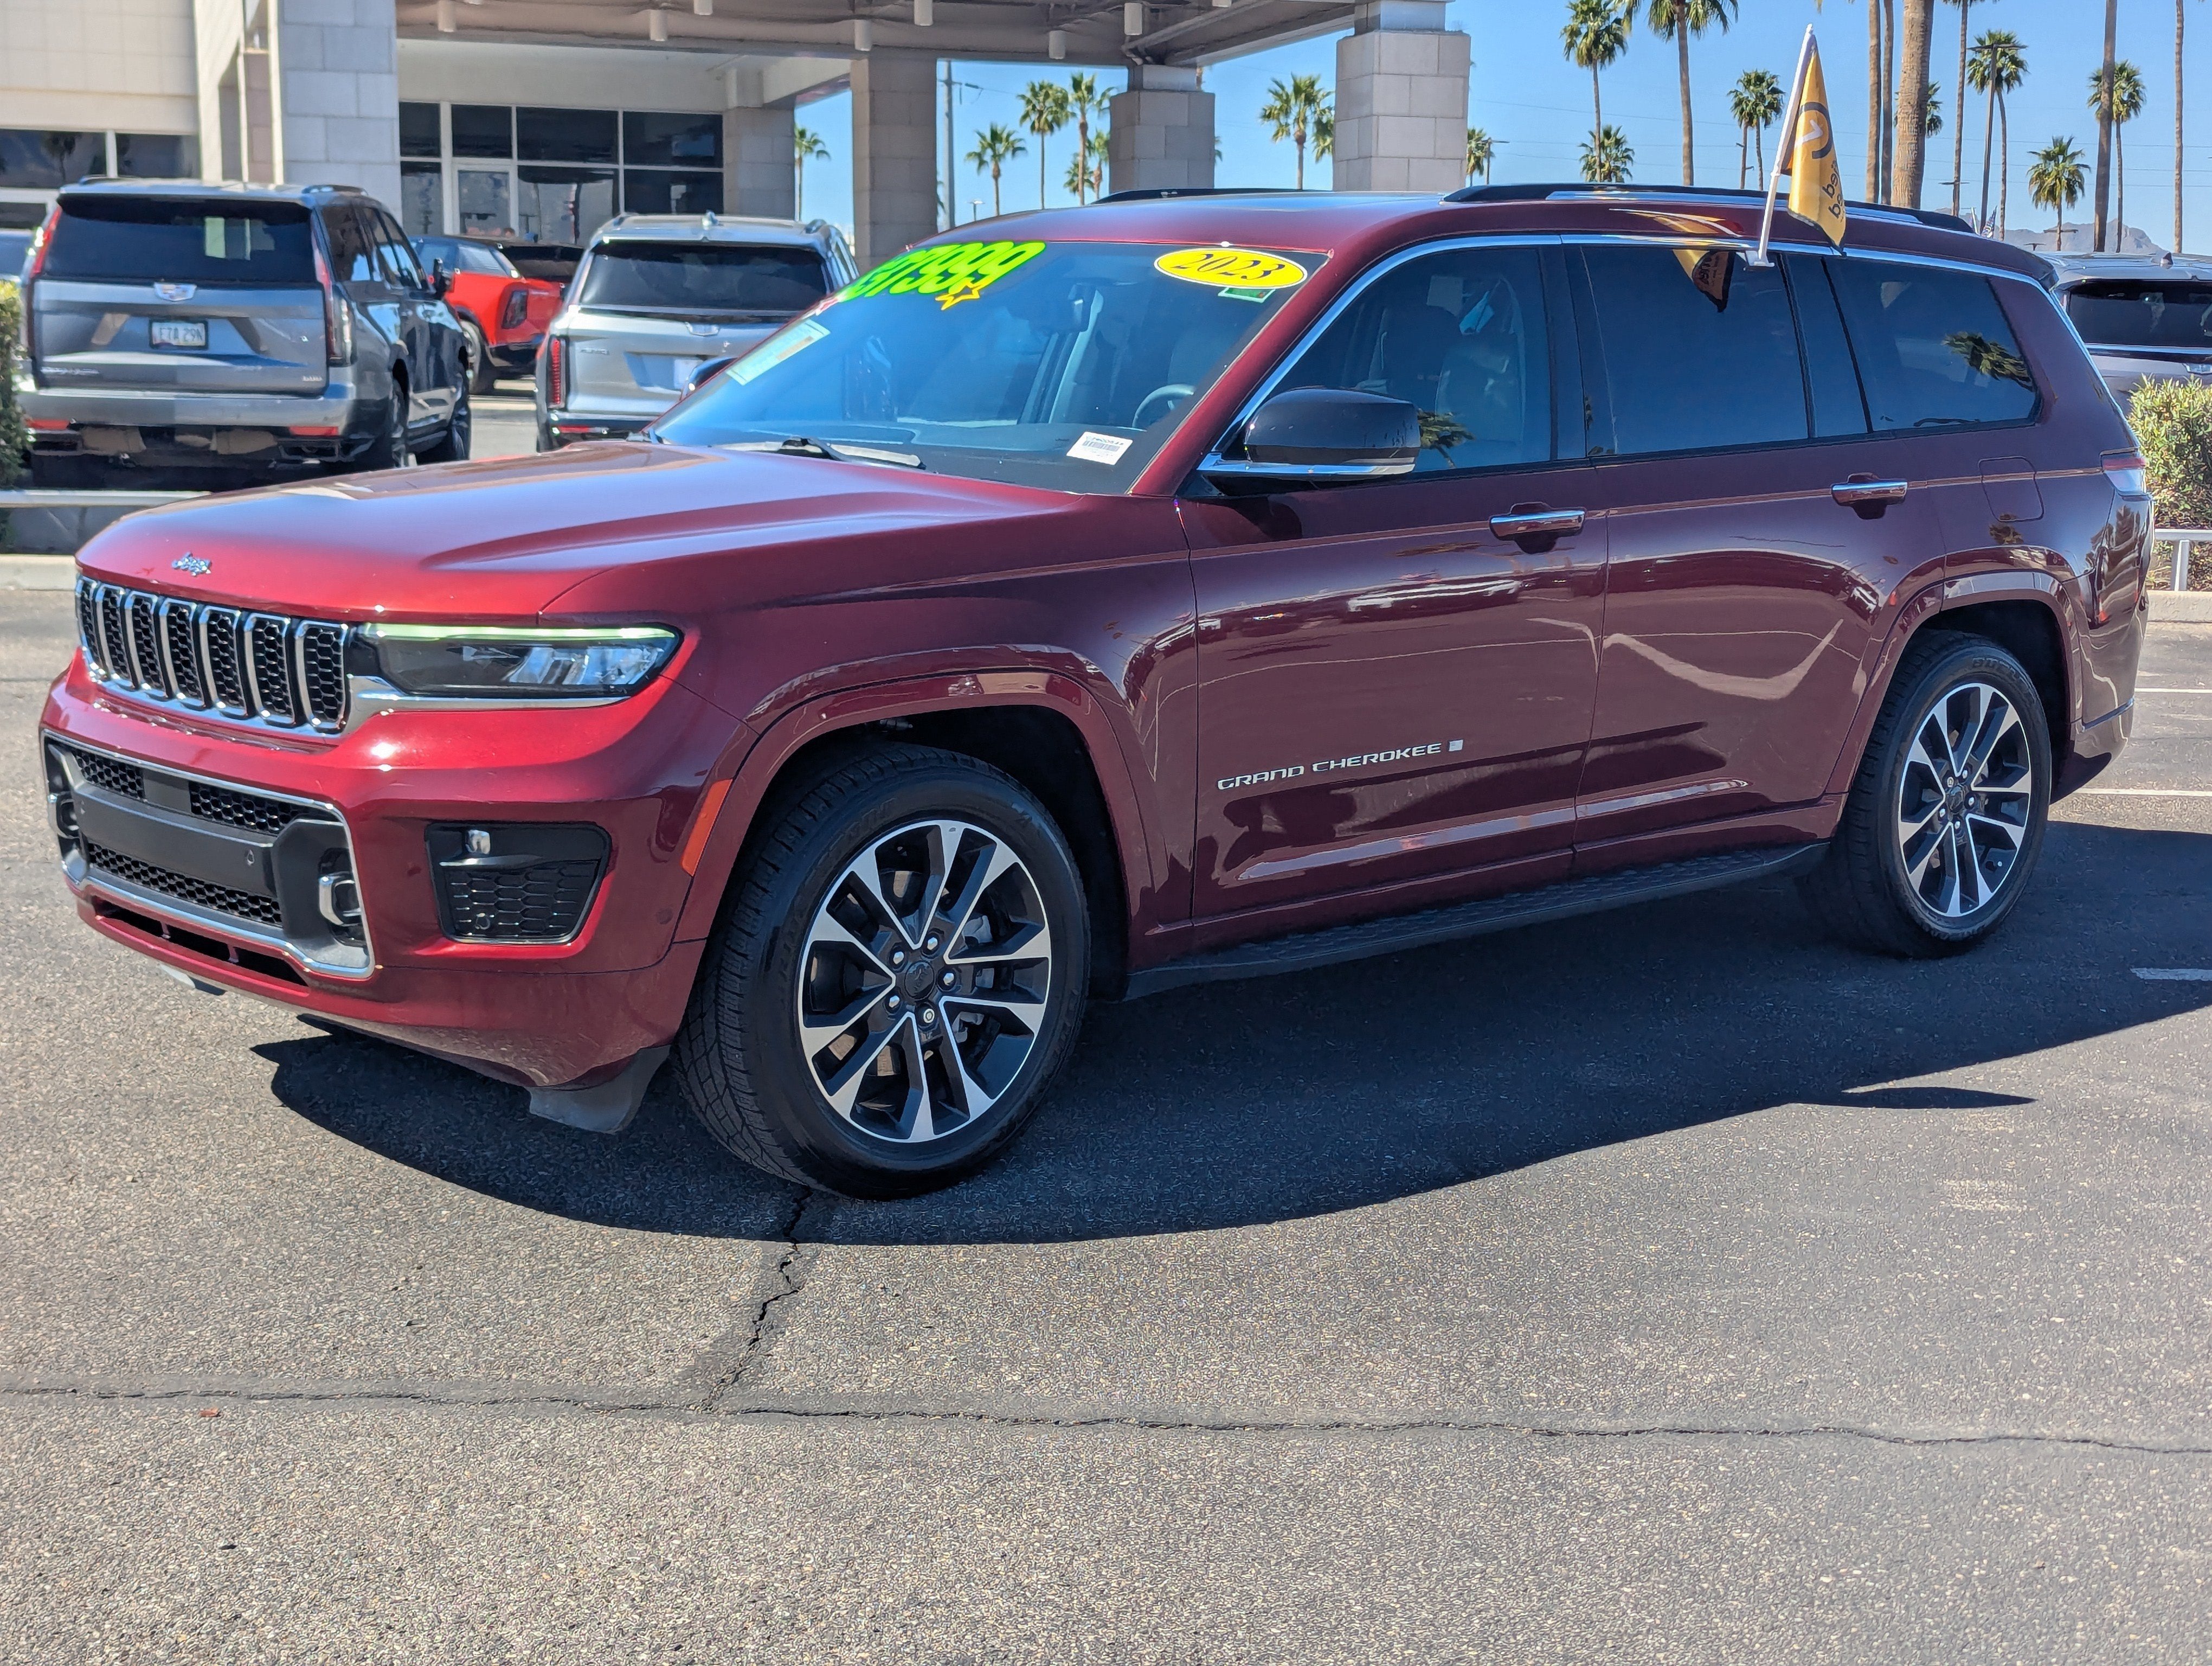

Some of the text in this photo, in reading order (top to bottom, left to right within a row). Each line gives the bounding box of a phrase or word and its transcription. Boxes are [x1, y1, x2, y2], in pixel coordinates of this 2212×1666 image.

[1169, 253, 1285, 280] 2023
[1217, 742, 1443, 791] GRAND CHEROKEE
